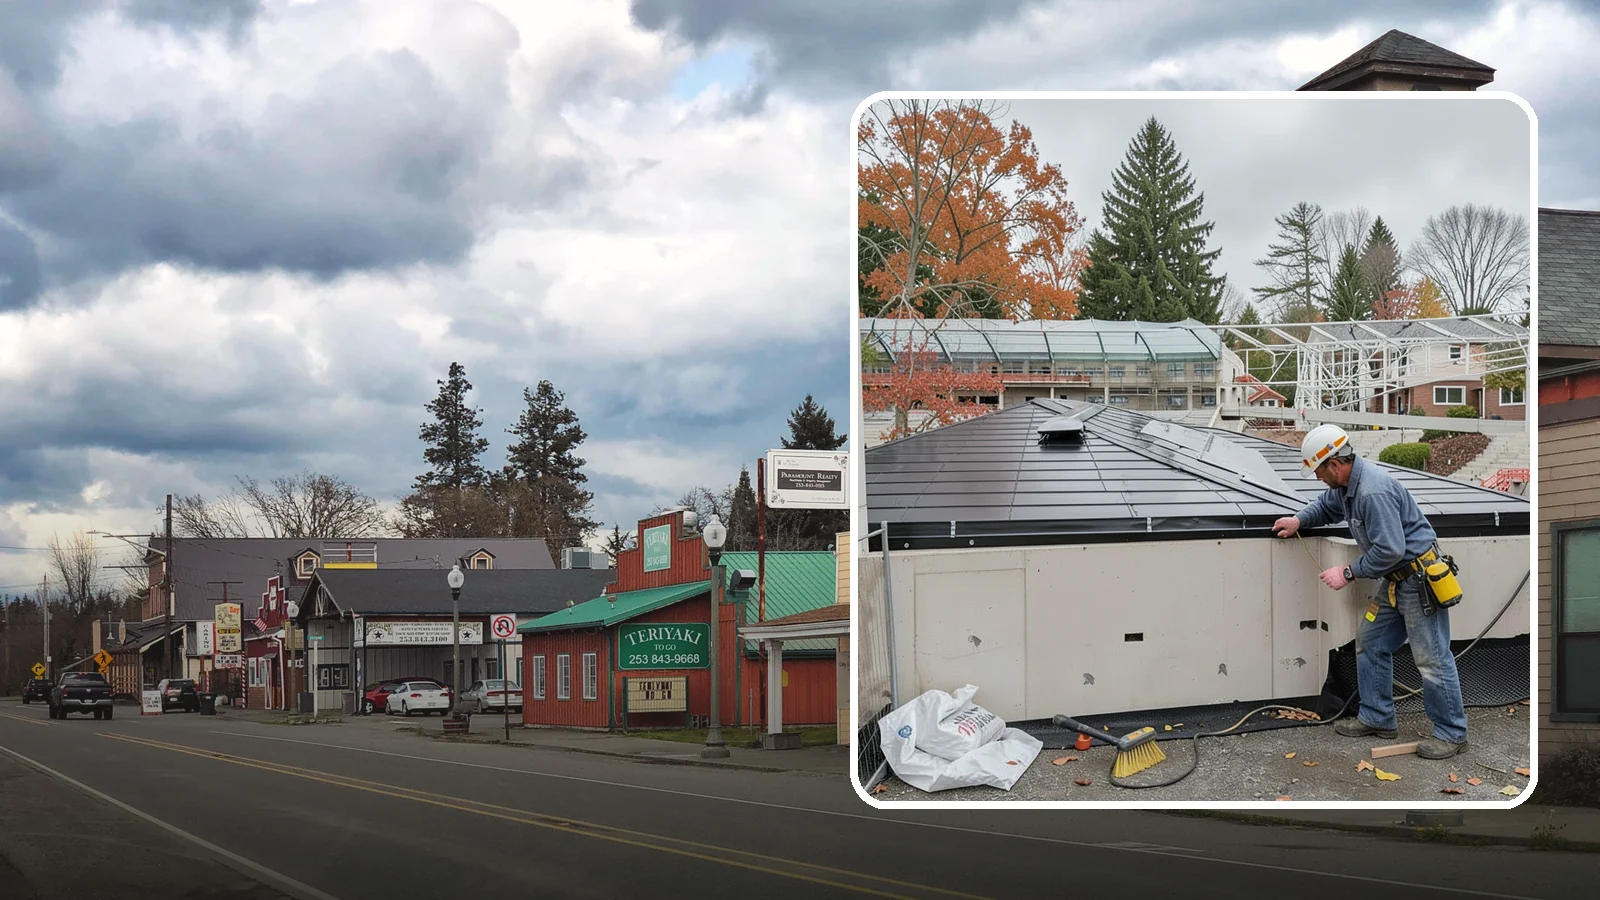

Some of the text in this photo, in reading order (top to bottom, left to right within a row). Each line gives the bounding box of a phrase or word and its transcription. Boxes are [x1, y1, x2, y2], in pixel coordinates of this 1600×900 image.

[625, 627, 702, 646] TERIYAKI
[629, 653, 700, 664] 253 843-9668
[639, 681, 672, 691] TERIYAKI
